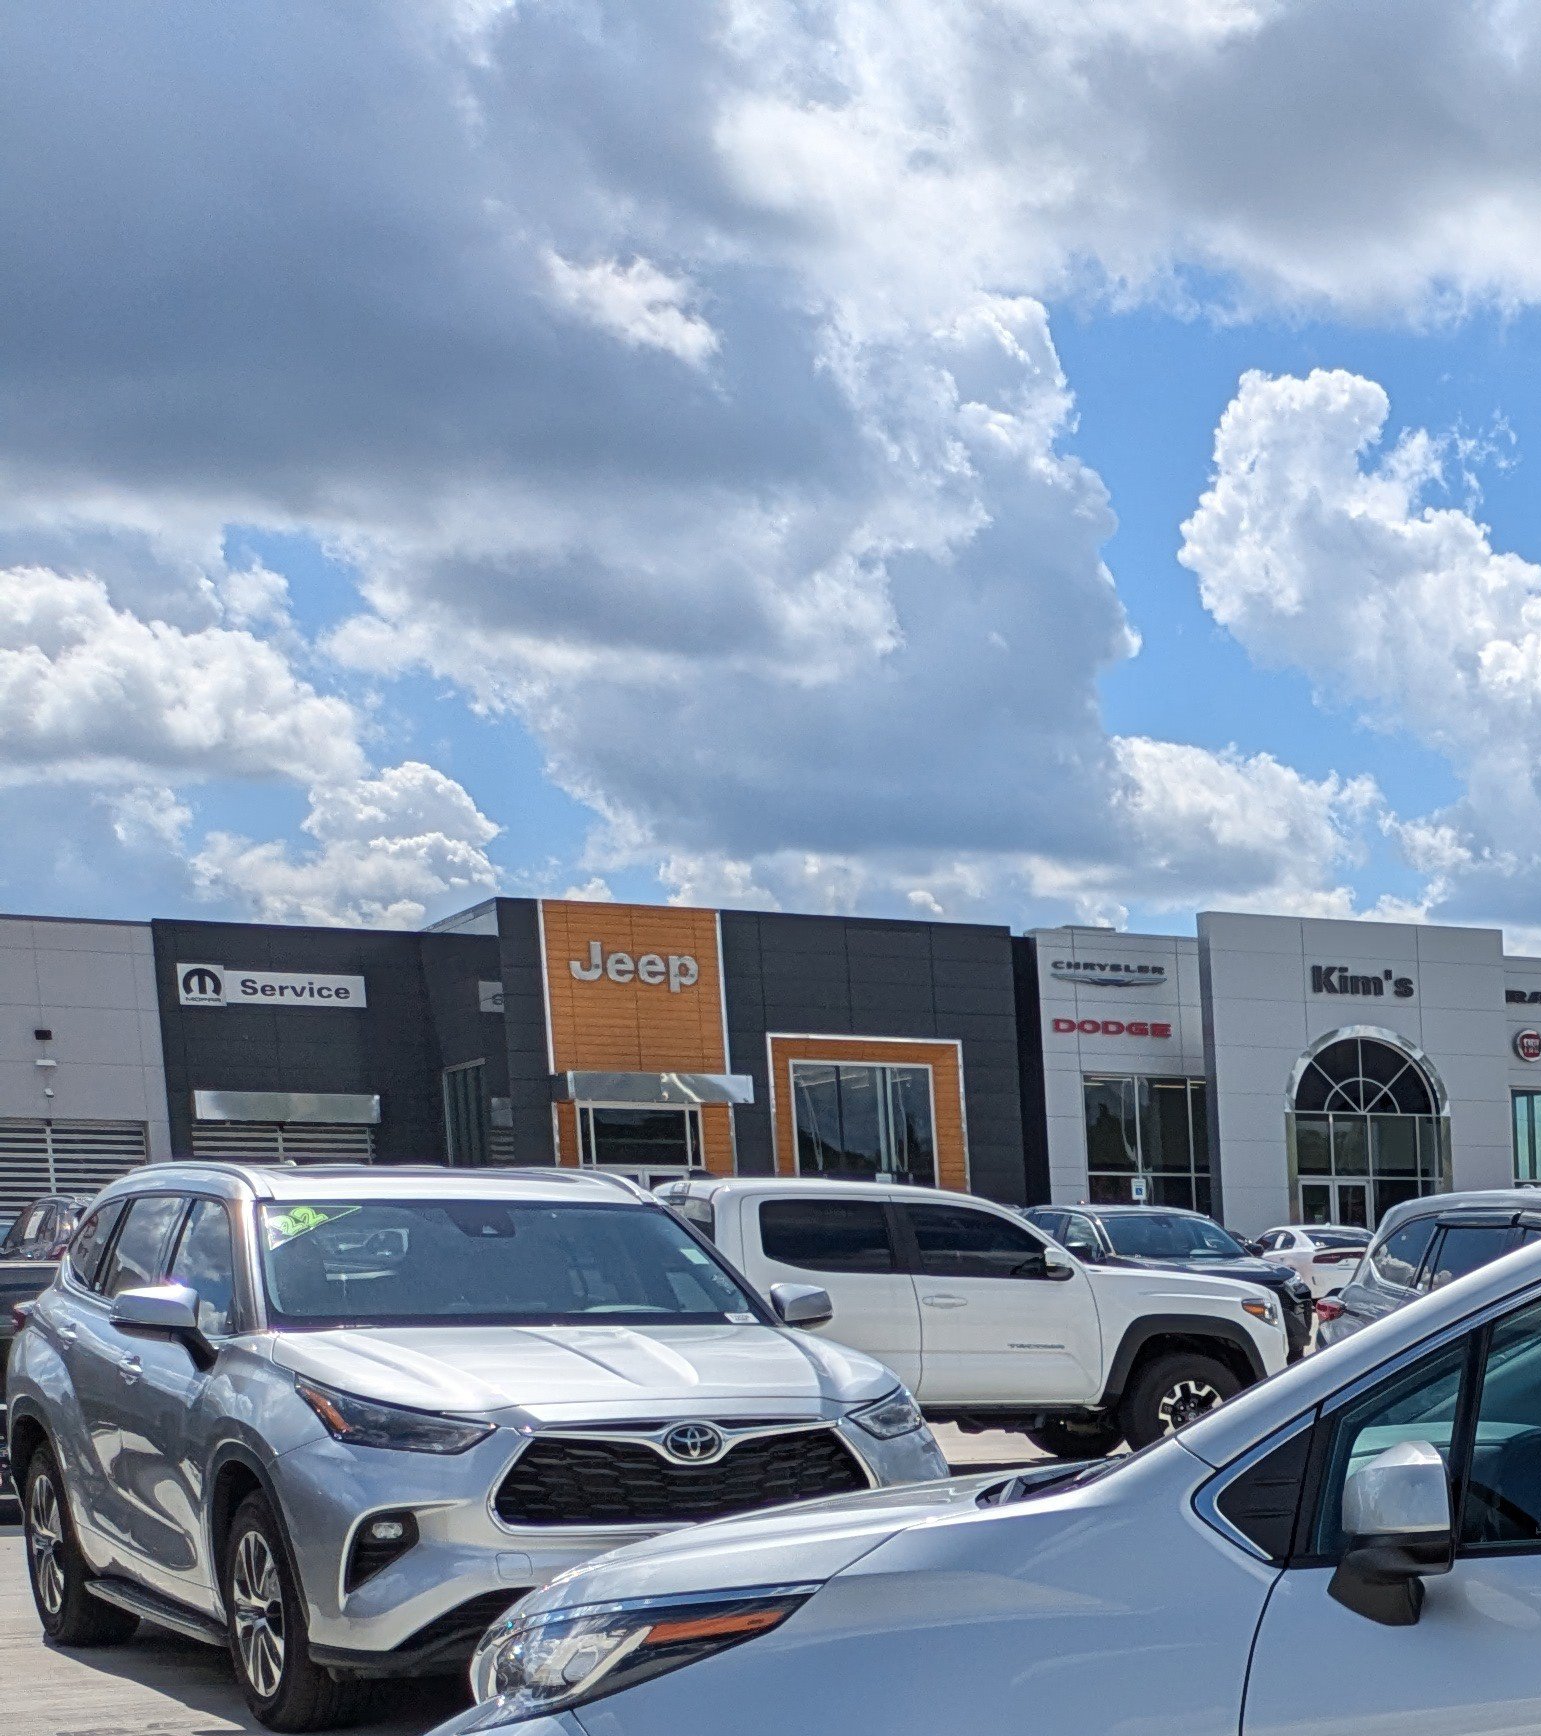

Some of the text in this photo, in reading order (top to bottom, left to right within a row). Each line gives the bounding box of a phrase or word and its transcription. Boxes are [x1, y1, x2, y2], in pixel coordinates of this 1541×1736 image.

[569, 941, 699, 993] Jeep
[1051, 960, 1165, 975] CHRYSLER
[240, 978, 350, 999] Service
[1311, 965, 1414, 998] Kim's
[1052, 1018, 1172, 1039] DODGE
[268, 1206, 329, 1236] 22
